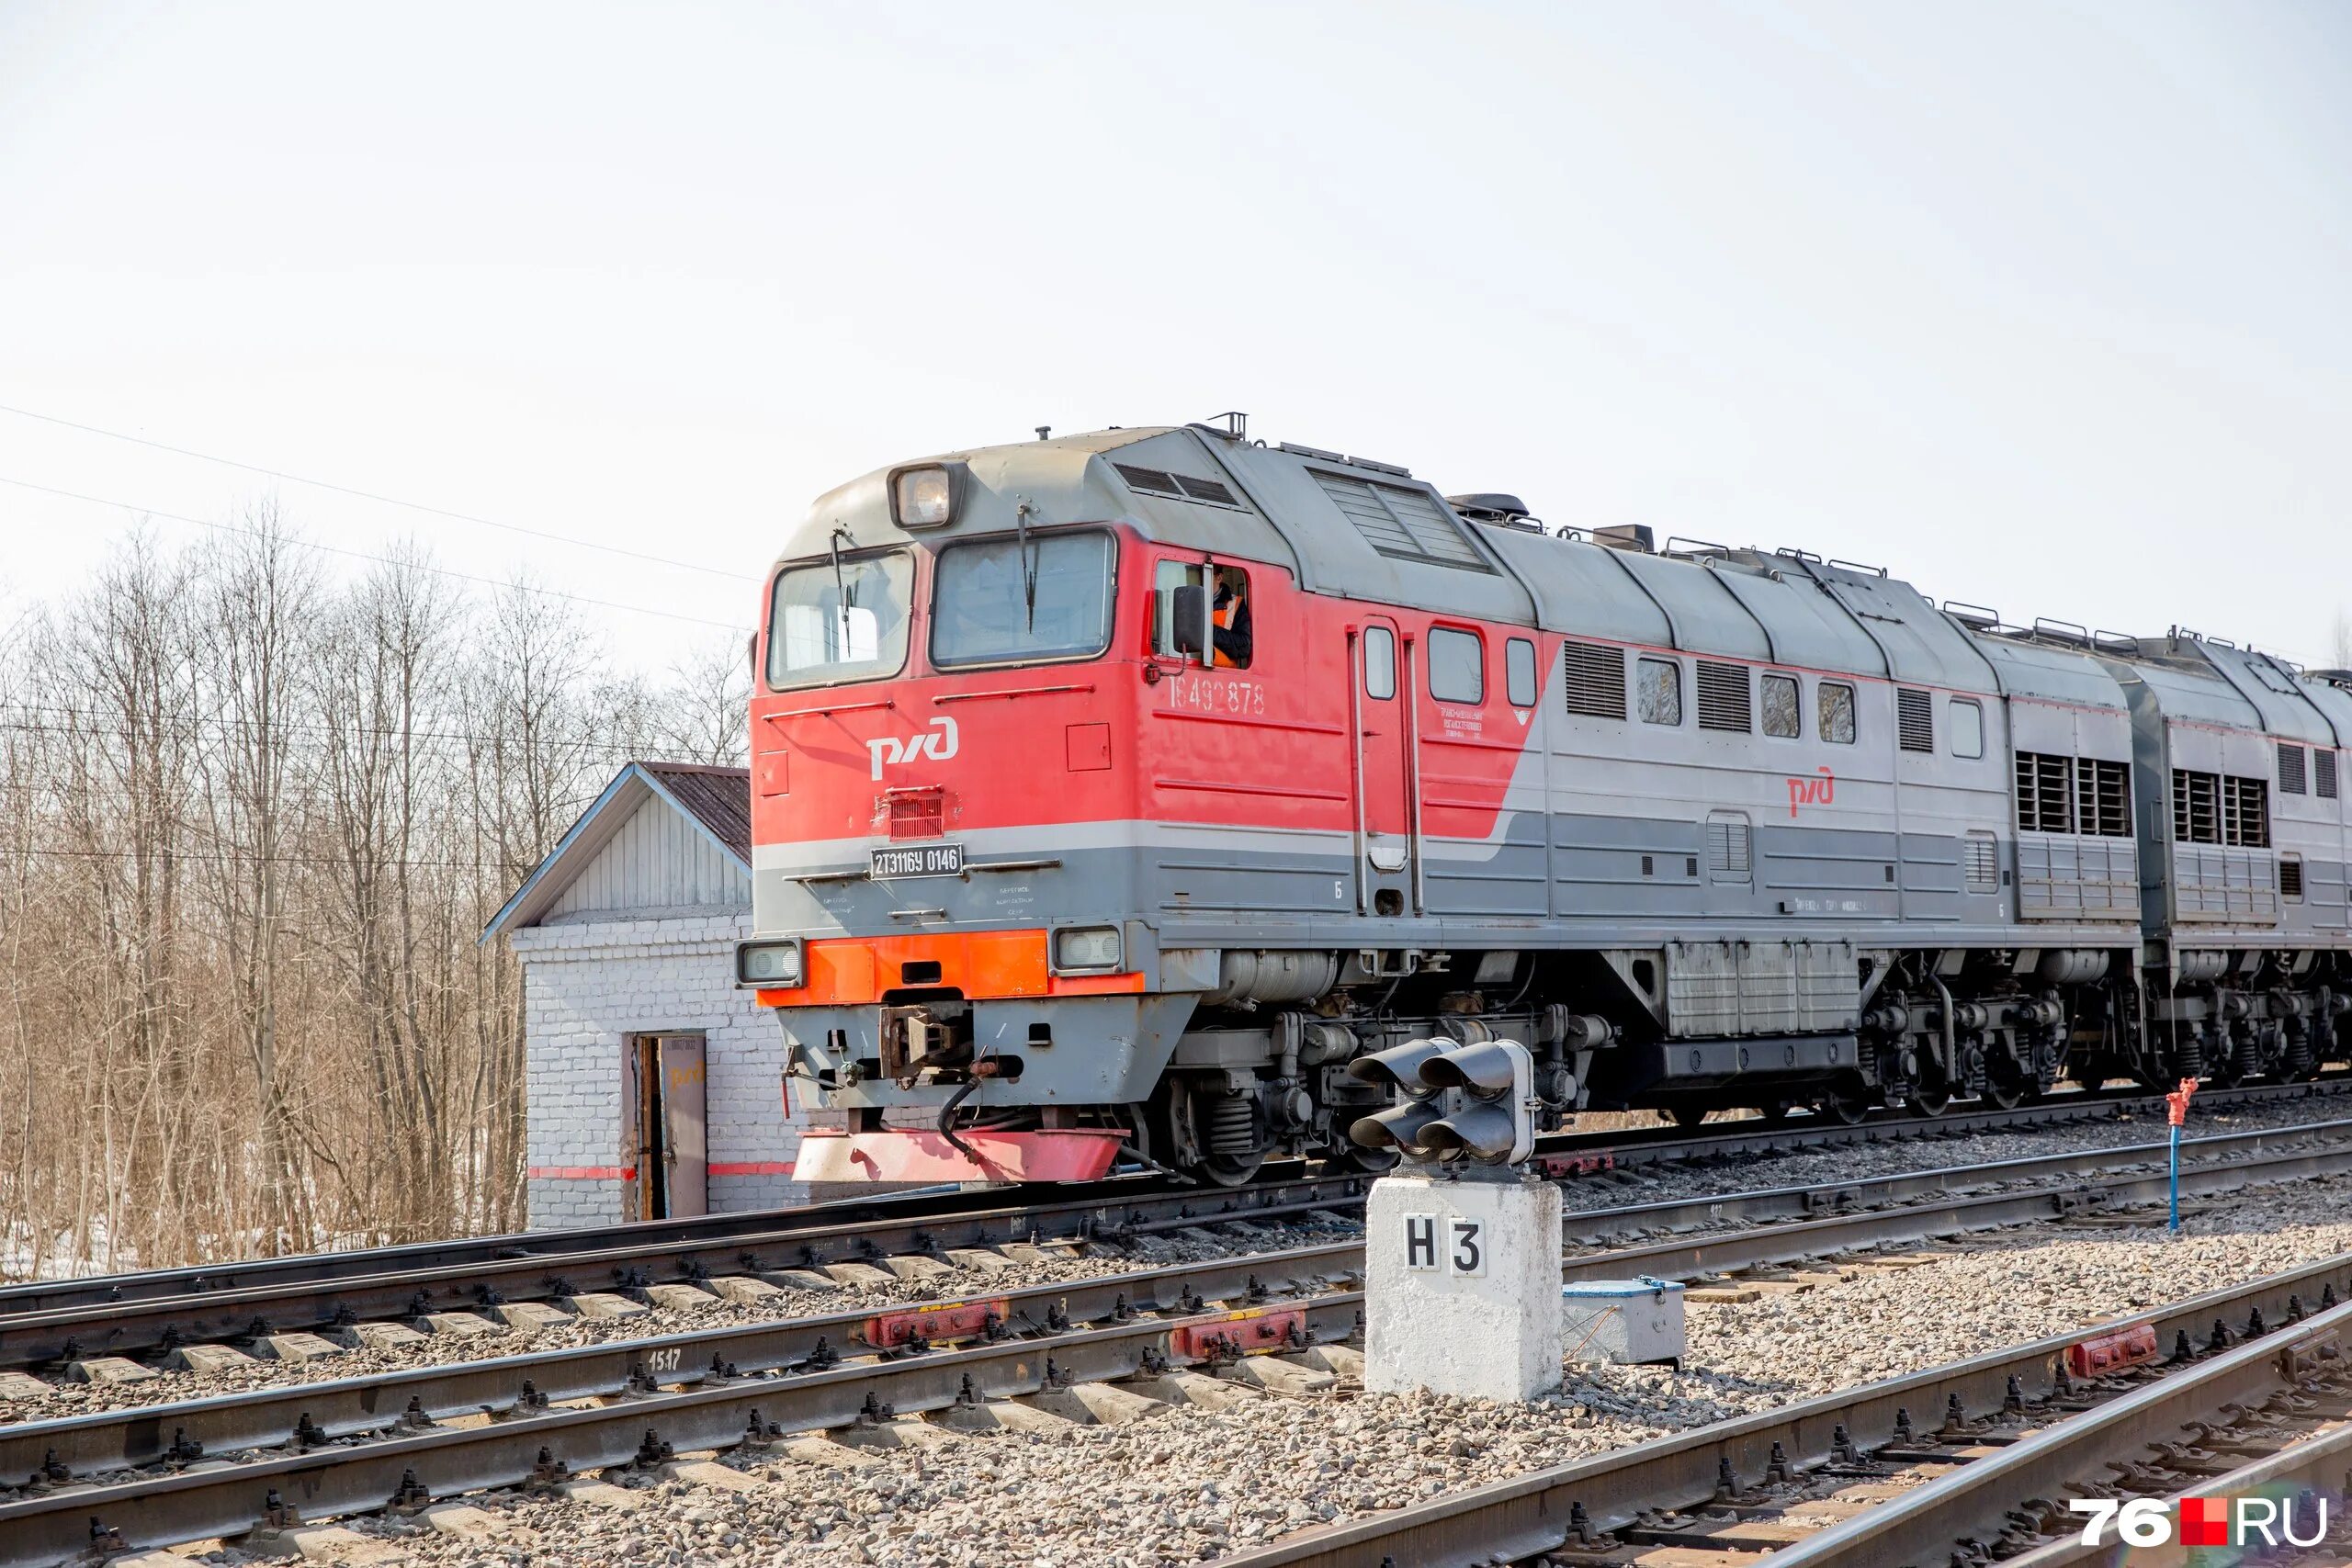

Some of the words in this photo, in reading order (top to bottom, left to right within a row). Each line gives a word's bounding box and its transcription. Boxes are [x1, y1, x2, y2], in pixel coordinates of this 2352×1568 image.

[875, 851, 923, 874] 2ТЭ116У
[927, 849, 957, 872] 0146
[1453, 1224, 1480, 1271] 3
